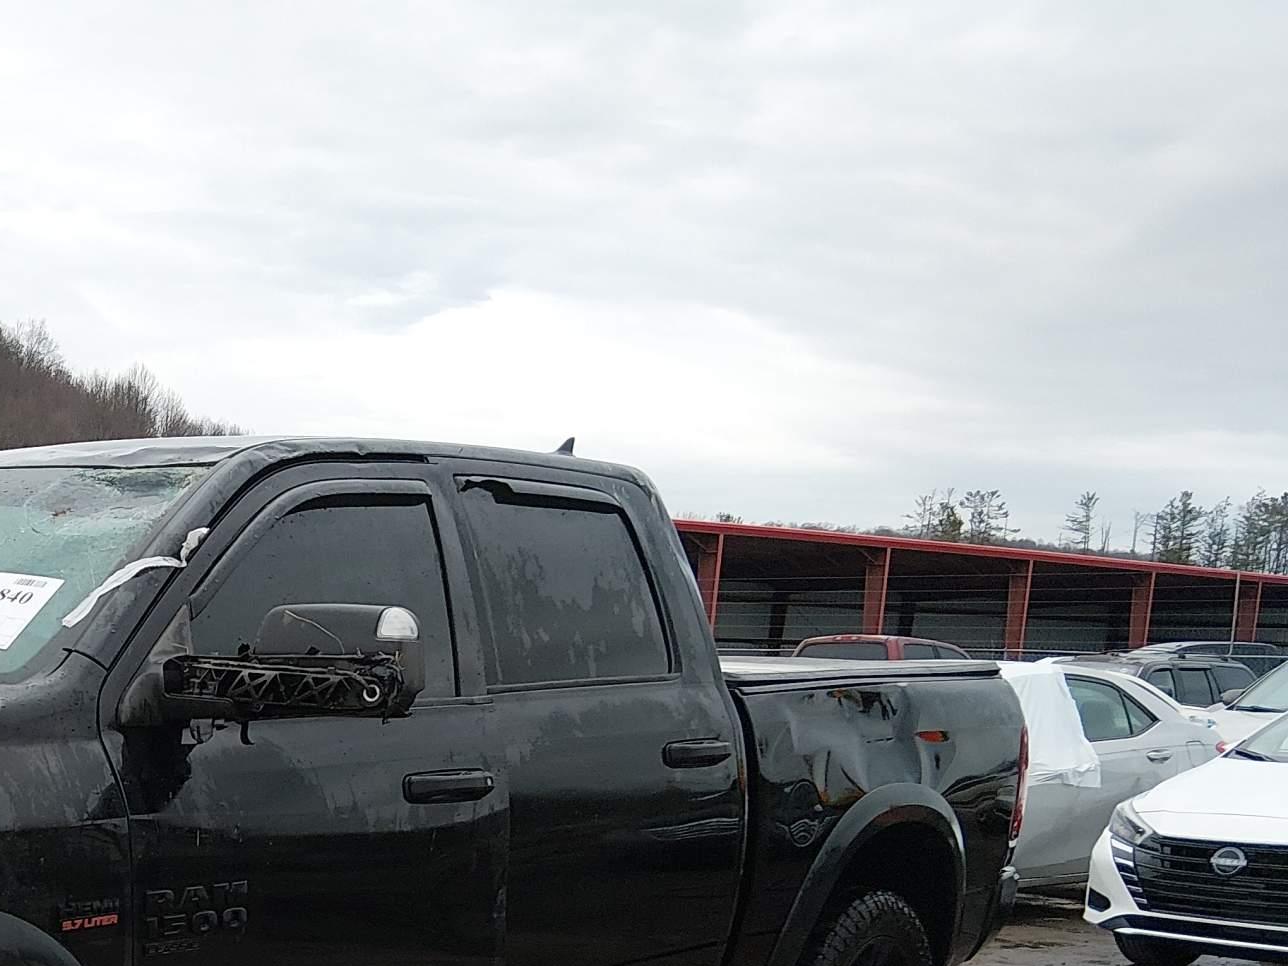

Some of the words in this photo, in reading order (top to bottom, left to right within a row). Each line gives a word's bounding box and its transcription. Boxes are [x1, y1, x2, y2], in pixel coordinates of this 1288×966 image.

[145, 880, 249, 909] RAM
[61, 919, 83, 932] 5.7
[83, 914, 119, 928] LITER
[145, 906, 249, 937] 1500
